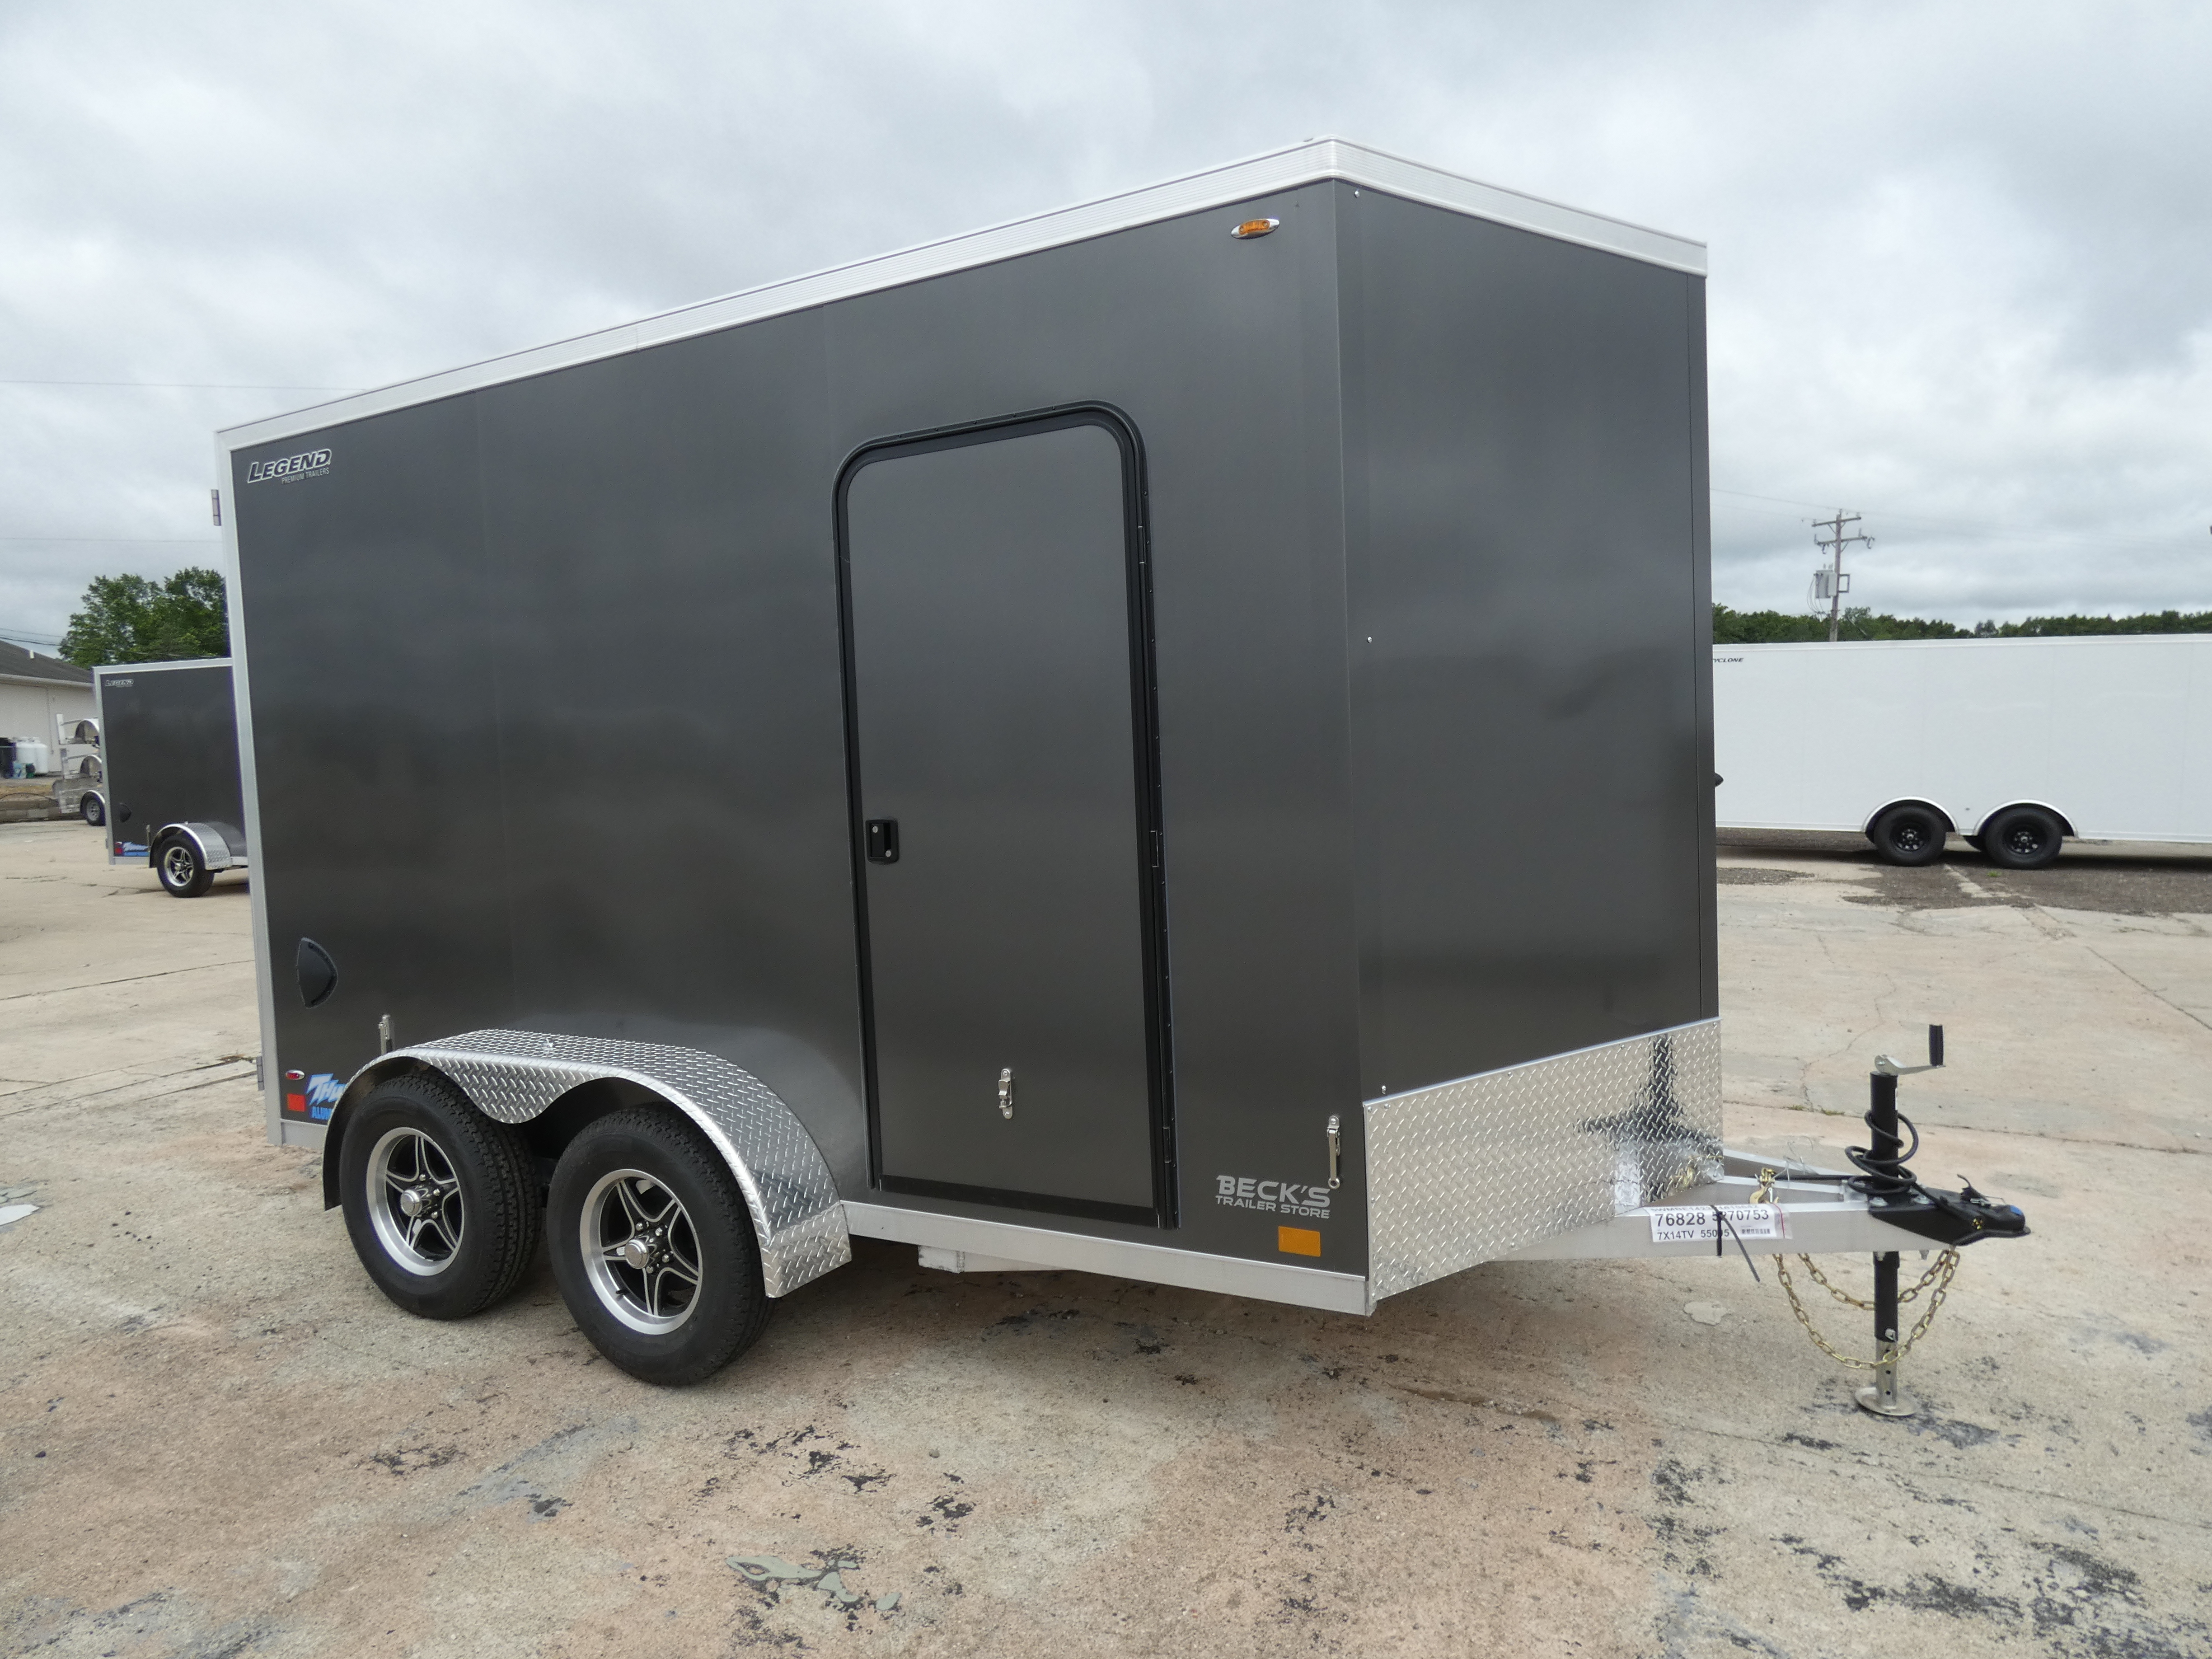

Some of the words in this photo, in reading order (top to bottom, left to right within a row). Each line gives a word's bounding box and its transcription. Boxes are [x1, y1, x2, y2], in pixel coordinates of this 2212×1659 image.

[248, 449, 332, 483] LEGEND
[281, 473, 305, 484] PREMIUM
[306, 467, 329, 478] TRAILERS
[1216, 1175, 1331, 1208] BECK'S
[1215, 1195, 1276, 1212] TRAILER
[1280, 1204, 1331, 1219] STORE
[1655, 1212, 1706, 1227] 76828
[1657, 1230, 1694, 1240] 7X14TV
[1701, 1229, 1729, 1238] 5505
